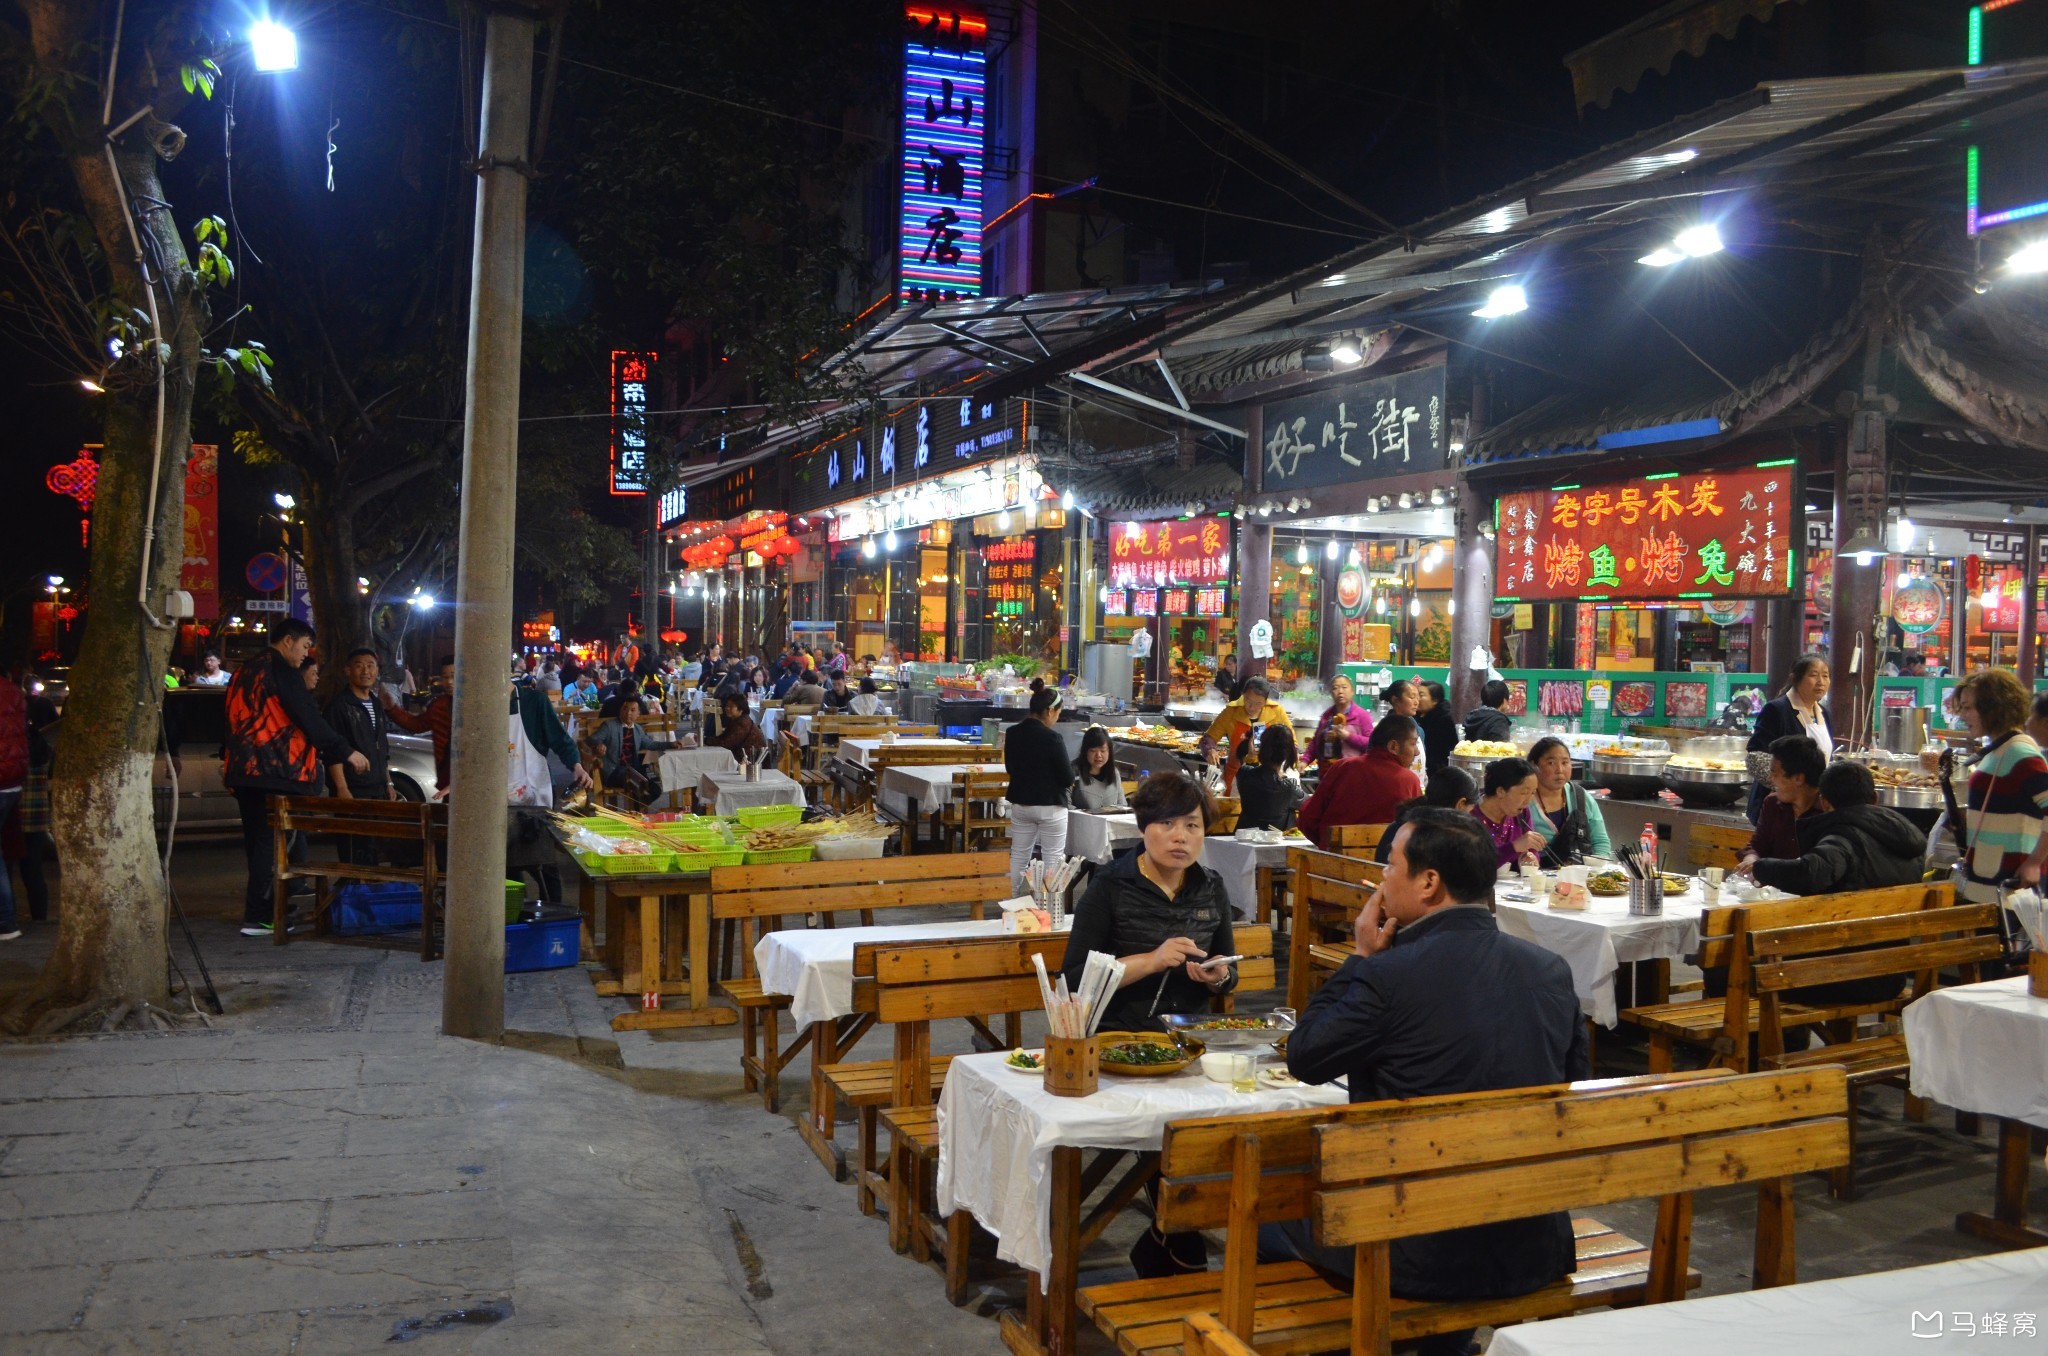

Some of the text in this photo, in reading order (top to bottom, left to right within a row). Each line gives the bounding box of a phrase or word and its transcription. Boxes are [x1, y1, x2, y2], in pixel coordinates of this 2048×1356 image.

[828, 406, 929, 490] 仙山饭店
[1266, 398, 1420, 480] 好吃街
[1115, 520, 1221, 558] 好吃第一家
[1552, 479, 1724, 529] 老字号木炭
[1736, 490, 1757, 574] 九大碗
[1763, 481, 1778, 582] 四十年老店
[1521, 508, 1538, 583] 鑫鑫店
[643, 993, 658, 1008] 11
